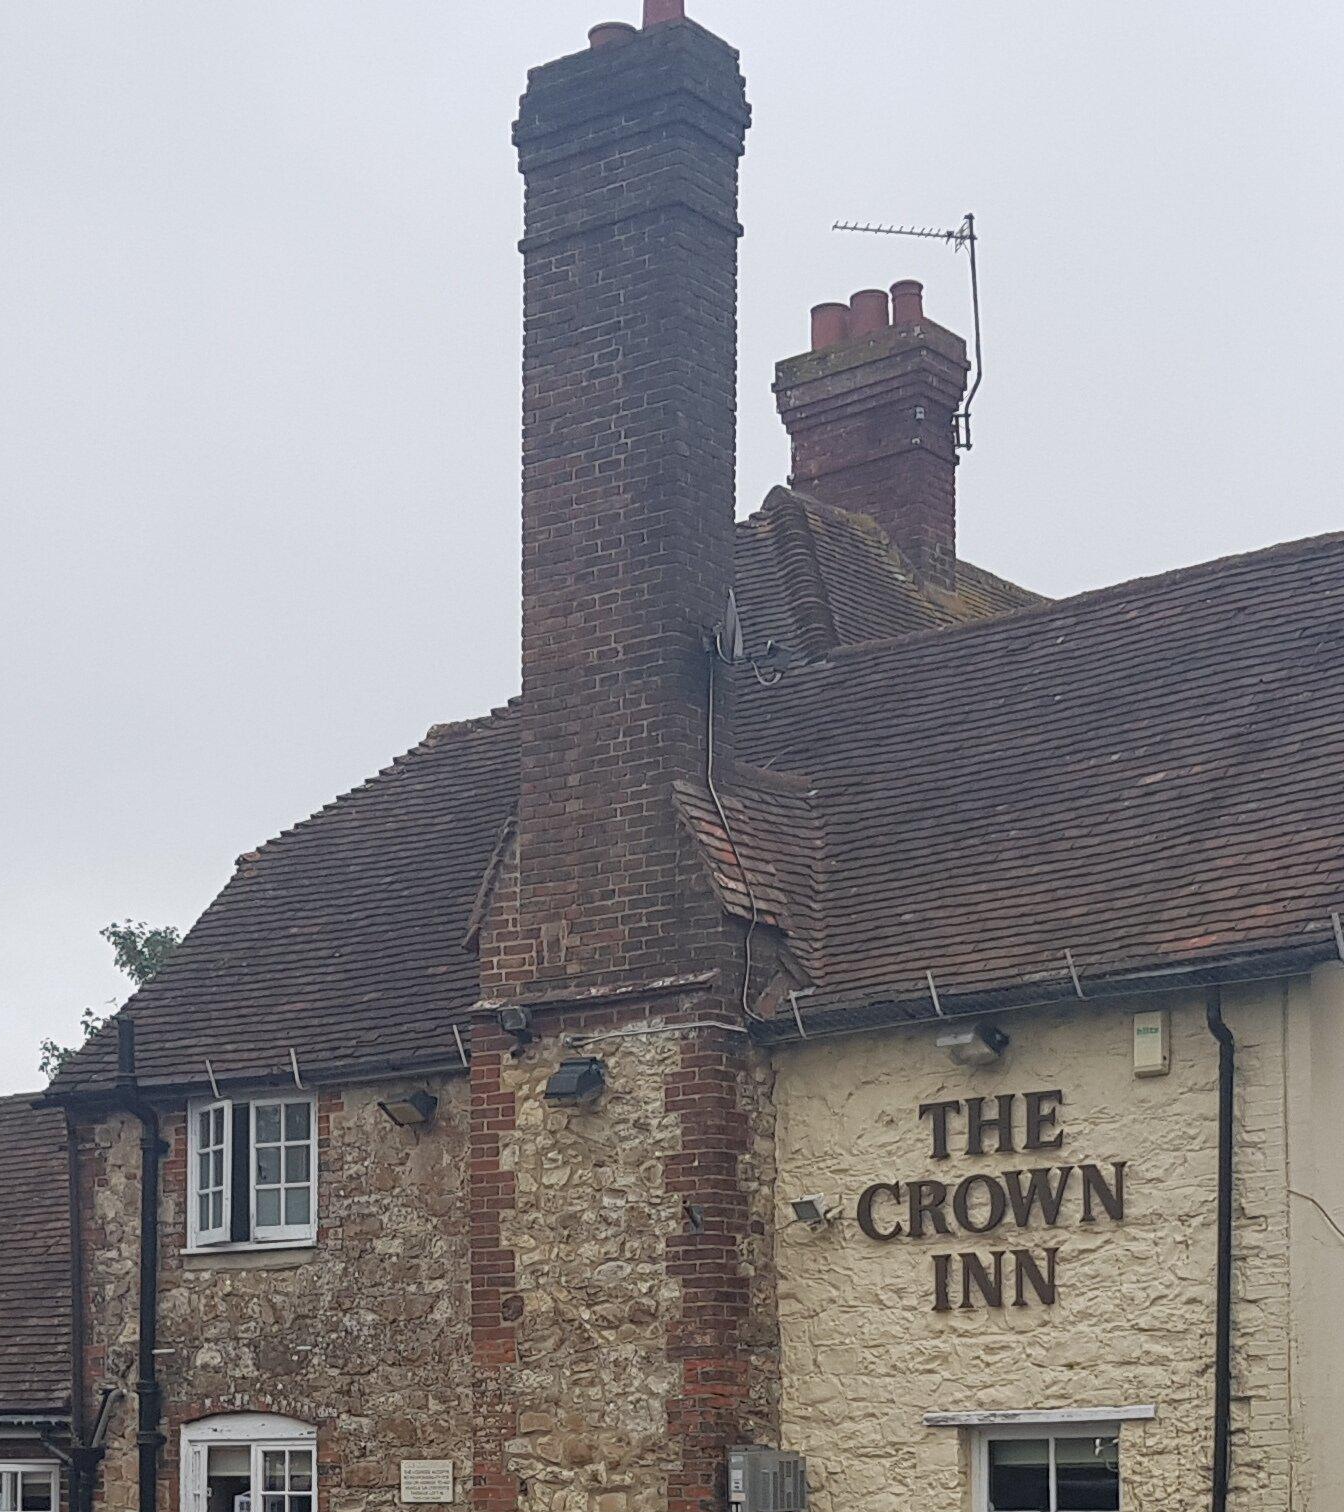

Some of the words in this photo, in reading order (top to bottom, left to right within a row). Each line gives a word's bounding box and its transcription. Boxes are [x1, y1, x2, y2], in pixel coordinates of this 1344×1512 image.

[918, 1089, 1064, 1160] THE
[857, 1161, 1127, 1241] CROWN
[931, 1247, 1059, 1312] INN
